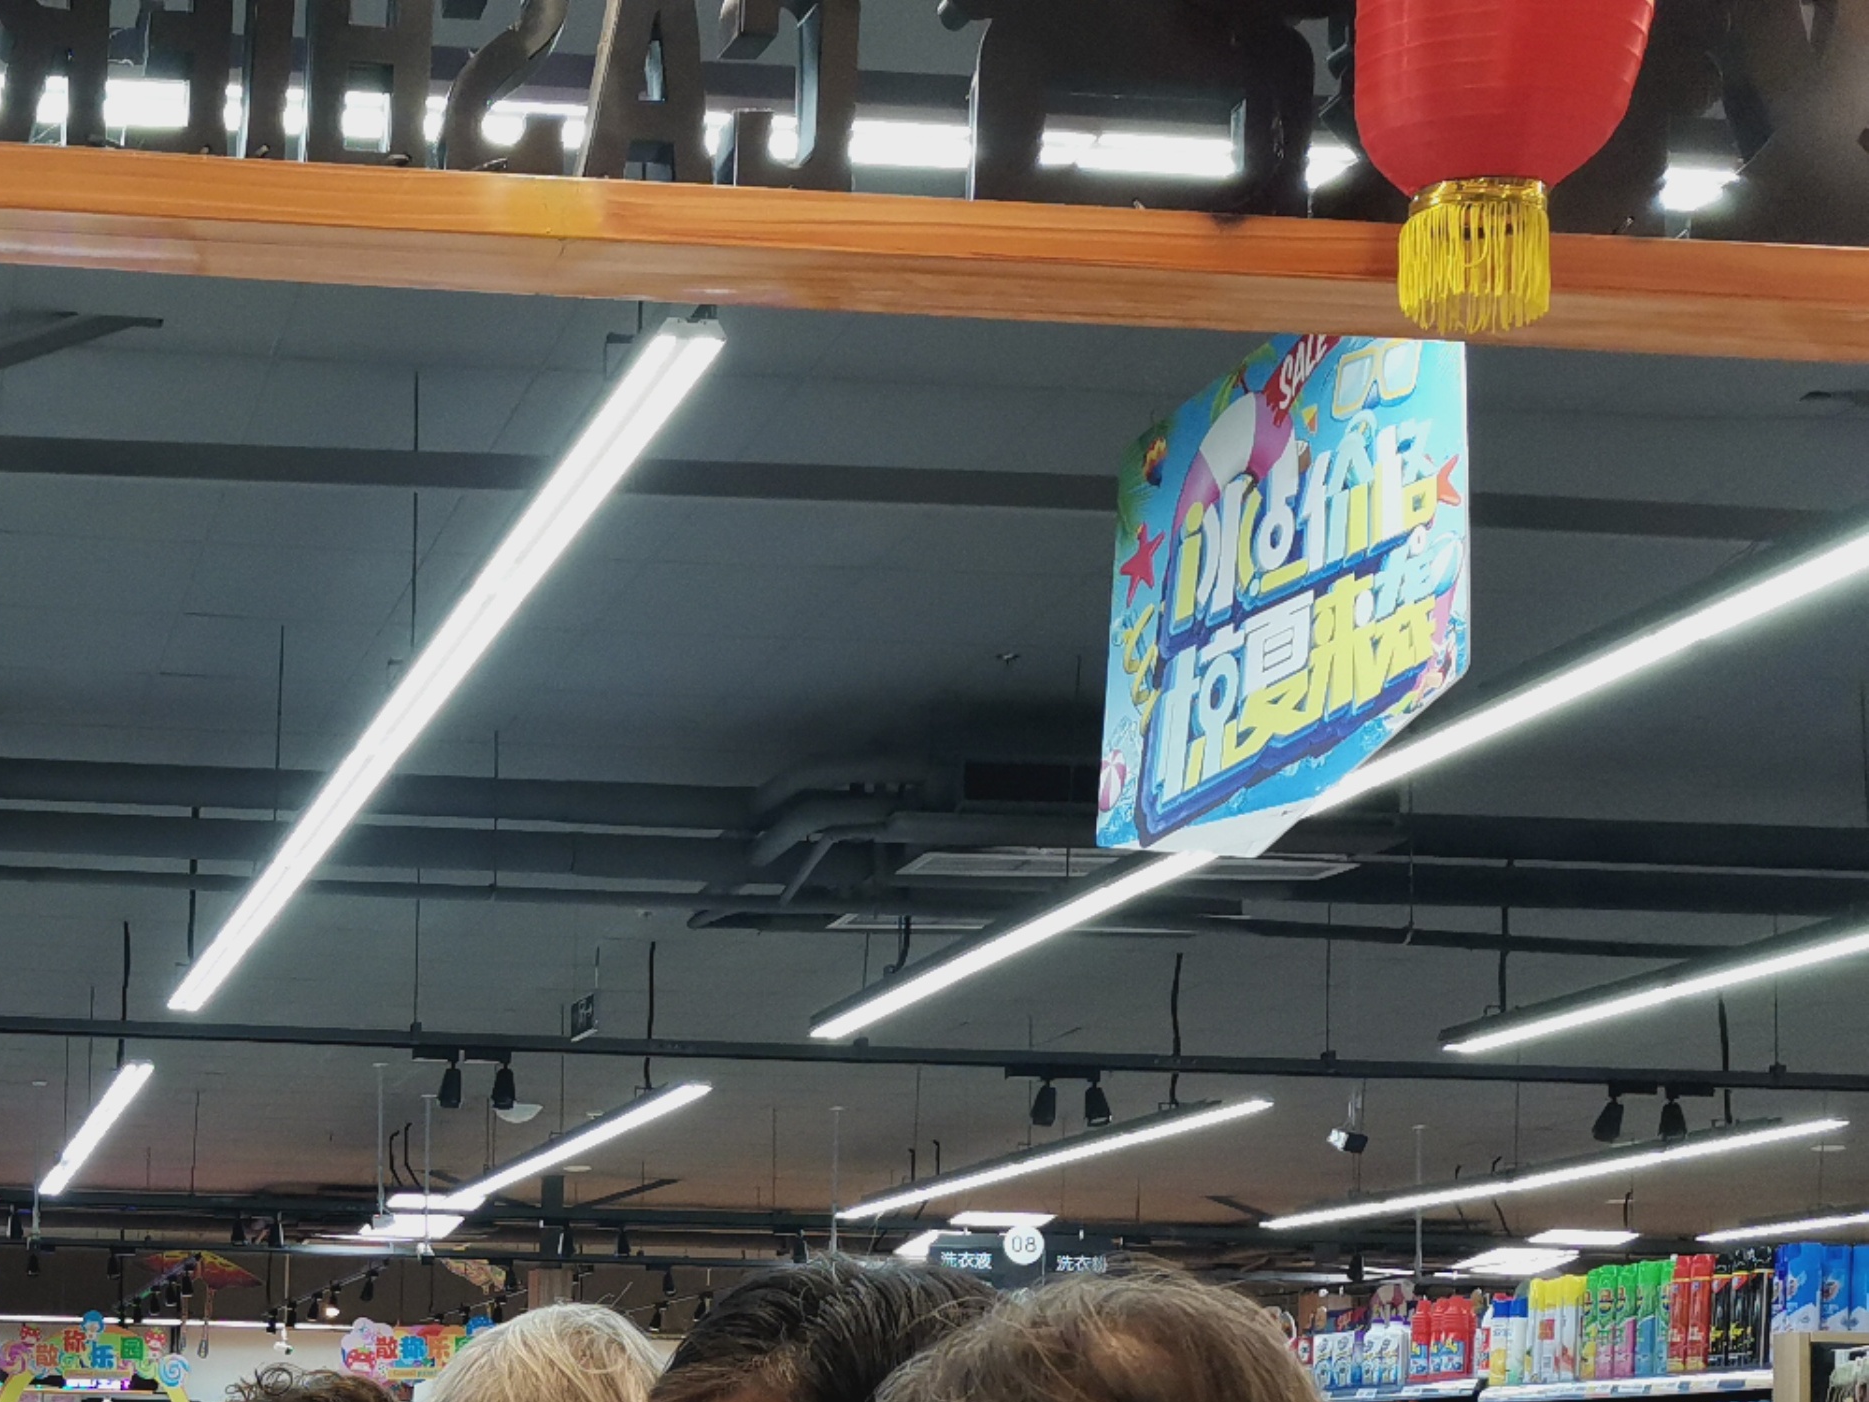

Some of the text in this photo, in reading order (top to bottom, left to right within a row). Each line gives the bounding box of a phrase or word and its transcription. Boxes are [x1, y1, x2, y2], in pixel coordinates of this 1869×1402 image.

[1277, 333, 1329, 408] SALE
[1011, 1235, 1037, 1253] 08
[940, 1251, 993, 1270] 洗衣液
